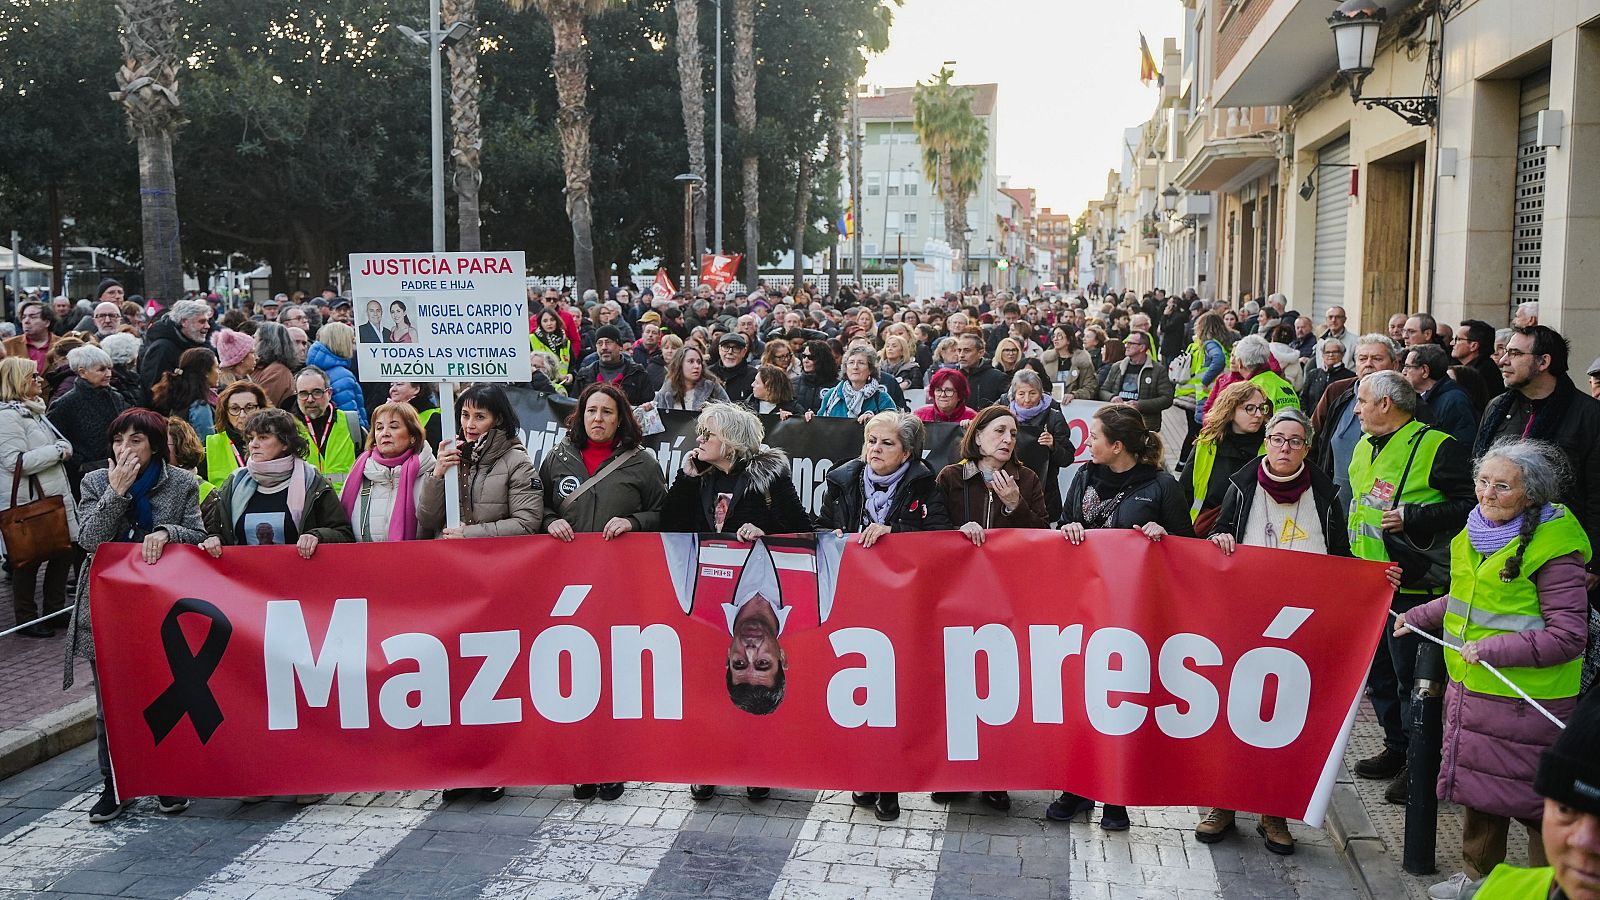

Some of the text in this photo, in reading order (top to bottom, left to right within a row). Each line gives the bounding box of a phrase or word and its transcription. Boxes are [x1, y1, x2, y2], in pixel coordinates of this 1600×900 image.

[361, 257, 513, 276] JUSTICIA PARA
[401, 280, 475, 290] PADRE E HIJA
[418, 303, 523, 317] MIGUEL CARPIO Y
[431, 322, 512, 335] SARA CARPIO
[369, 347, 517, 358] Y TODAS LAS VICTIMAS
[380, 360, 508, 375] MAZÓN PRISIÓN
[264, 584, 1315, 762] Mazón a presó
